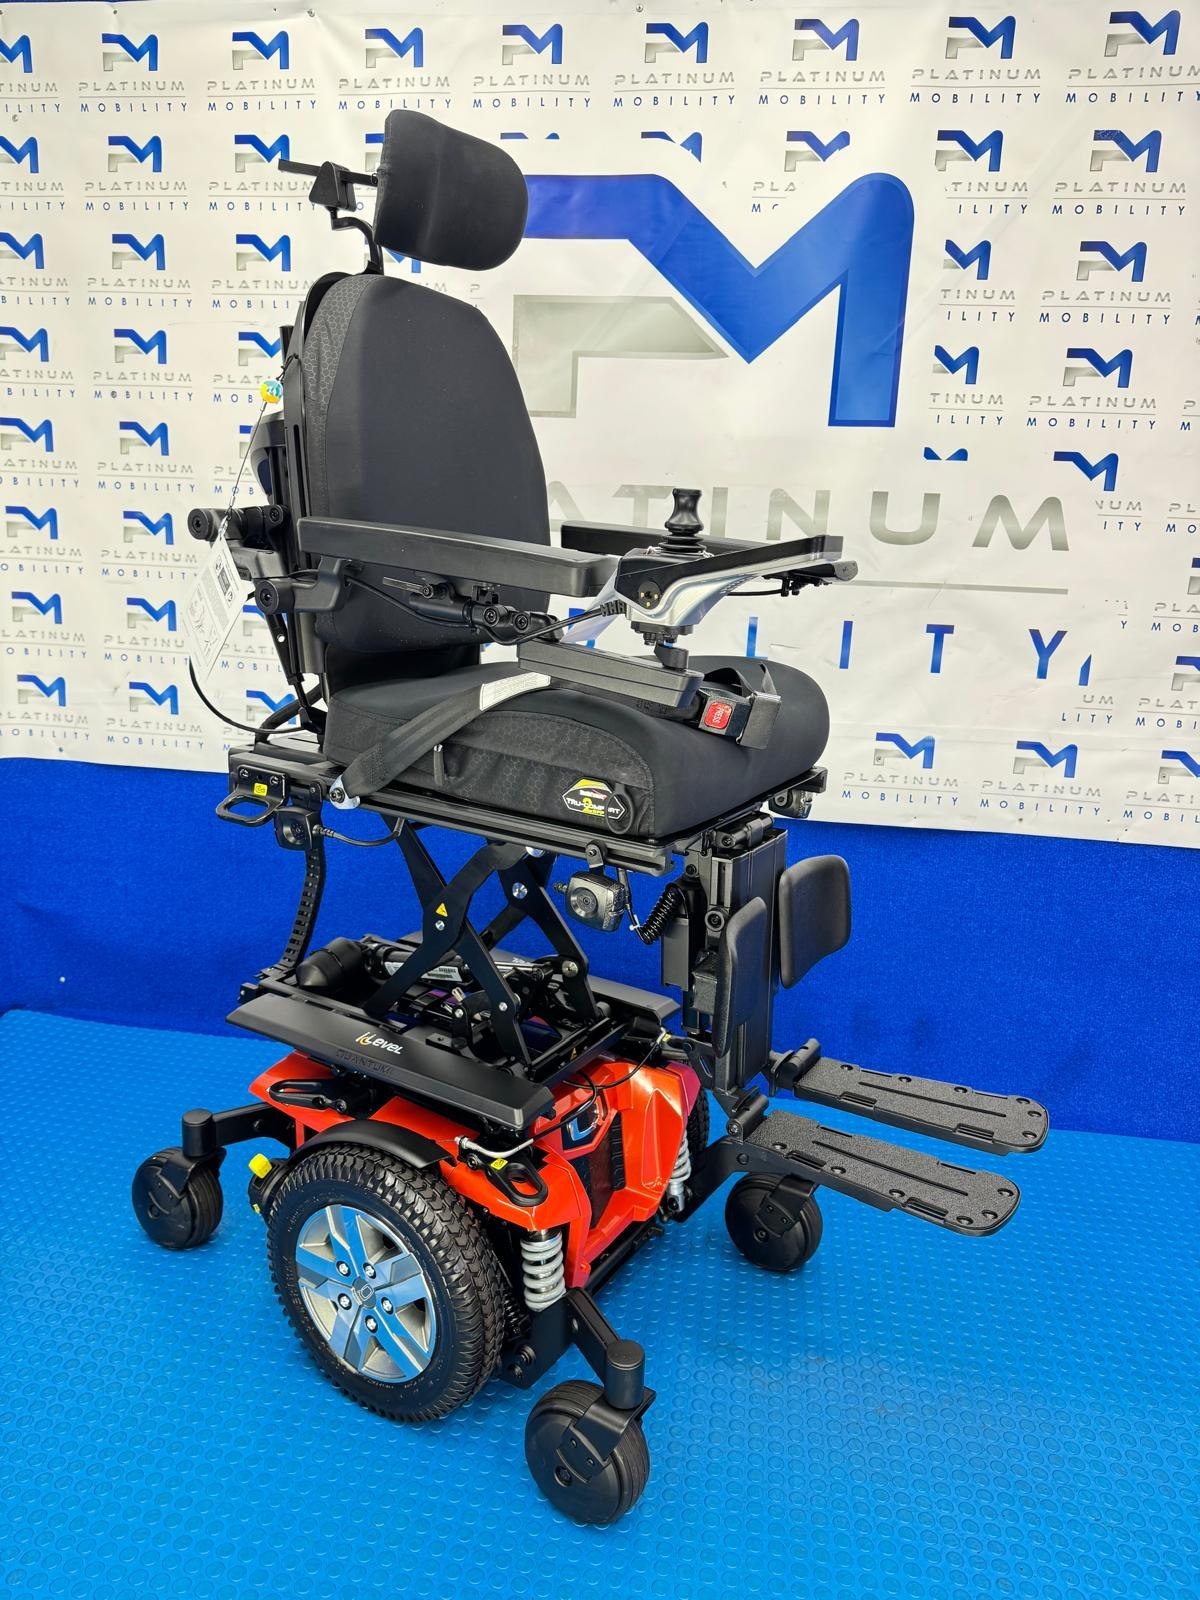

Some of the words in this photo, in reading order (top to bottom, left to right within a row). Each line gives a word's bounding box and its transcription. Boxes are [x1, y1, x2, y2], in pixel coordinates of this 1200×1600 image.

[473, 74, 590, 86] PLATINUM
[614, 72, 735, 85] PLATINUM
[759, 71, 886, 82] PLATINUM
[911, 69, 1041, 80] PLATINUM
[78, 81, 185, 91] PLATINUM
[207, 79, 315, 90] PLATINUM
[338, 77, 450, 88] PLATINUM
[473, 97, 590, 108] MOBILITY
[614, 95, 734, 107] MOBILITY
[759, 94, 885, 104] MOBILITY
[910, 93, 1040, 103] MOBILITY
[81, 103, 186, 112] MOBILITY
[208, 100, 315, 111] MOBILITY
[339, 99, 451, 109] MOBILITY
[84, 182, 187, 191] PLATINUM
[944, 182, 1029, 192] TINUM
[1054, 182, 1186, 193] PLATINUM
[0, 202, 64, 210] ILITY
[86, 202, 188, 210] MOBILITY
[1052, 205, 1184, 215] MOBILITY
[87, 278, 191, 288] PLATINUM
[88, 297, 192, 307] MOBILITY
[1041, 291, 1172, 302] PLATINUM
[211, 300, 300, 311] MOBILI
[1040, 313, 1170, 324] MOBILITY
[92, 371, 192, 382] PLATINUM
[94, 390, 192, 400] MOBILITY
[1029, 396, 1157, 408] PLATINUM
[1027, 418, 1155, 429] MOBILITY
[97, 462, 194, 473] PLATINUM
[98, 481, 195, 492] MOBILITY
[0, 546, 83, 556] ATINUM
[100, 549, 198, 563] PLATINUM
[104, 635, 184, 648] PLATINU
[104, 653, 187, 665] MOBILIT
[0, 712, 89, 726] LATINUM
[1136, 717, 1196, 729] MOBI
[105, 718, 203, 733] PLATINUM
[0, 729, 89, 740] OBILITY
[107, 736, 203, 749] MOBILITY
[843, 772, 959, 787] PLATINUM
[980, 780, 1102, 799] PLATINUM
[842, 789, 957, 805] MOBILITY
[980, 799, 1100, 815] MOBILITY
[1123, 810, 1200, 823] MOBIL
